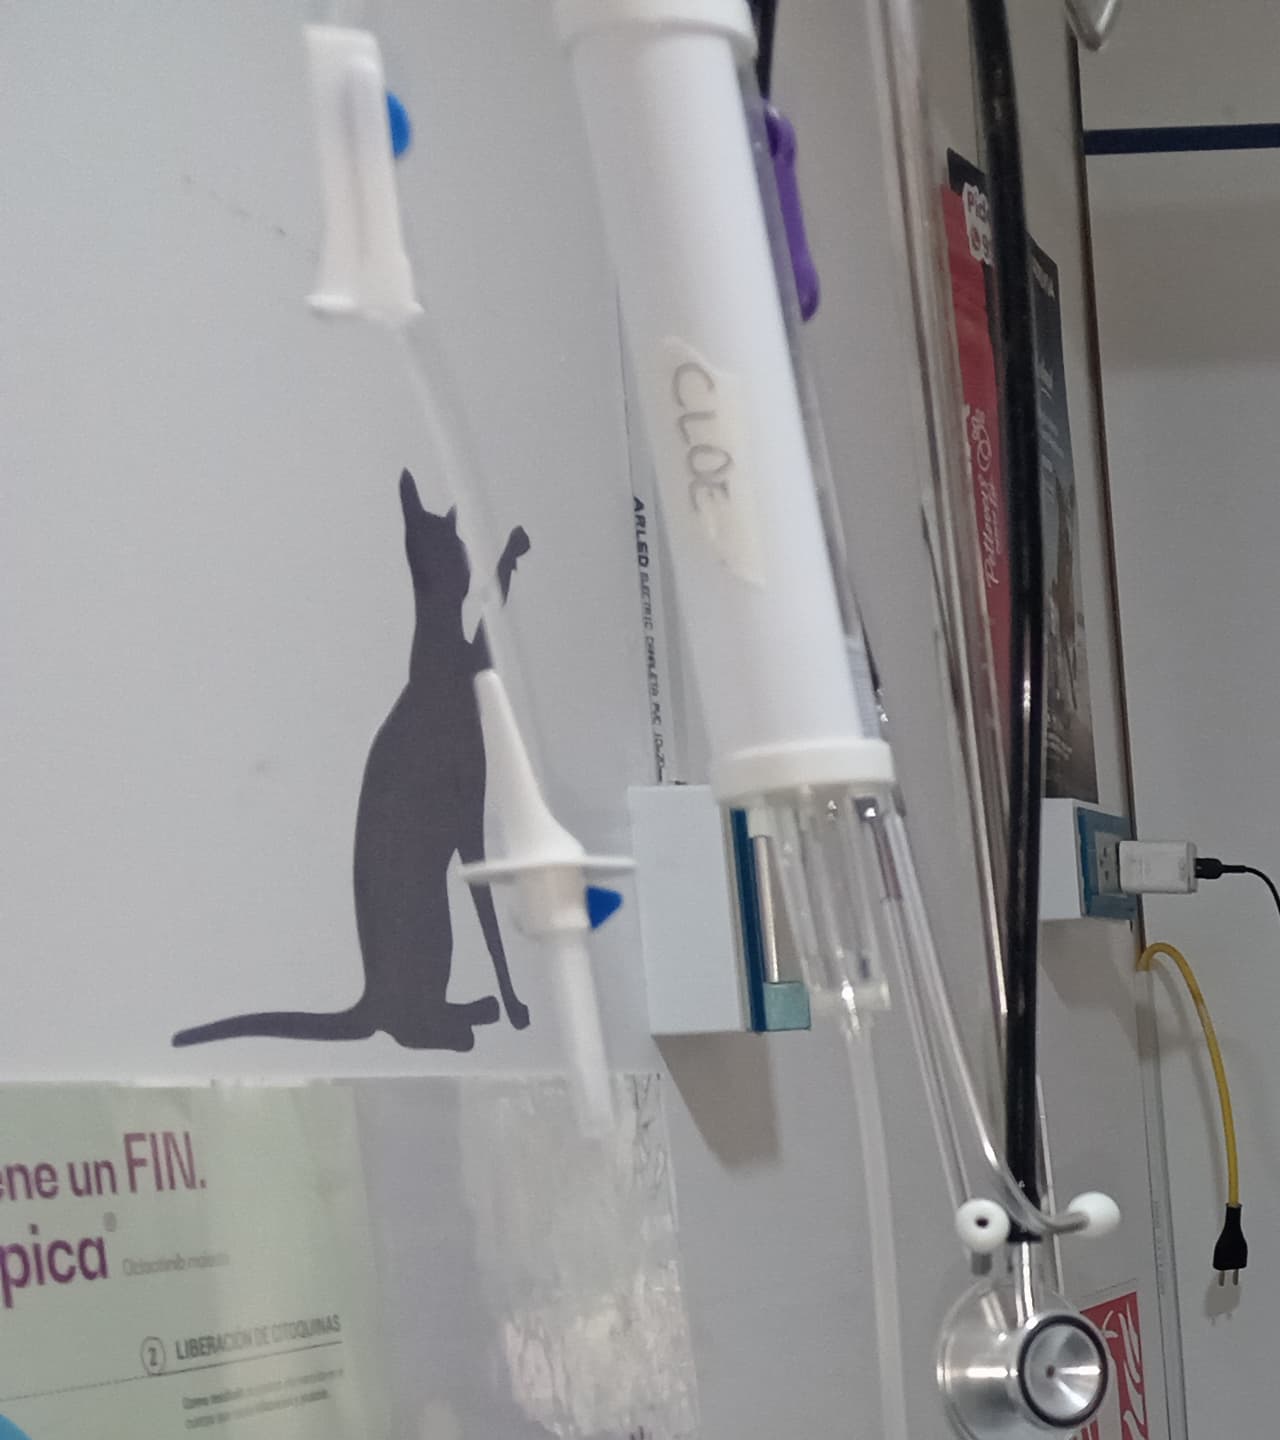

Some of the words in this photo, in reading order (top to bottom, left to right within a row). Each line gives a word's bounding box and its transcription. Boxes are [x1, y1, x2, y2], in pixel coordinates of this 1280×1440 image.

[671, 361, 735, 512] CLOE
[633, 496, 650, 568] ARLED
[67, 1160, 118, 1197] un
[124, 1131, 206, 1193] FIN.
